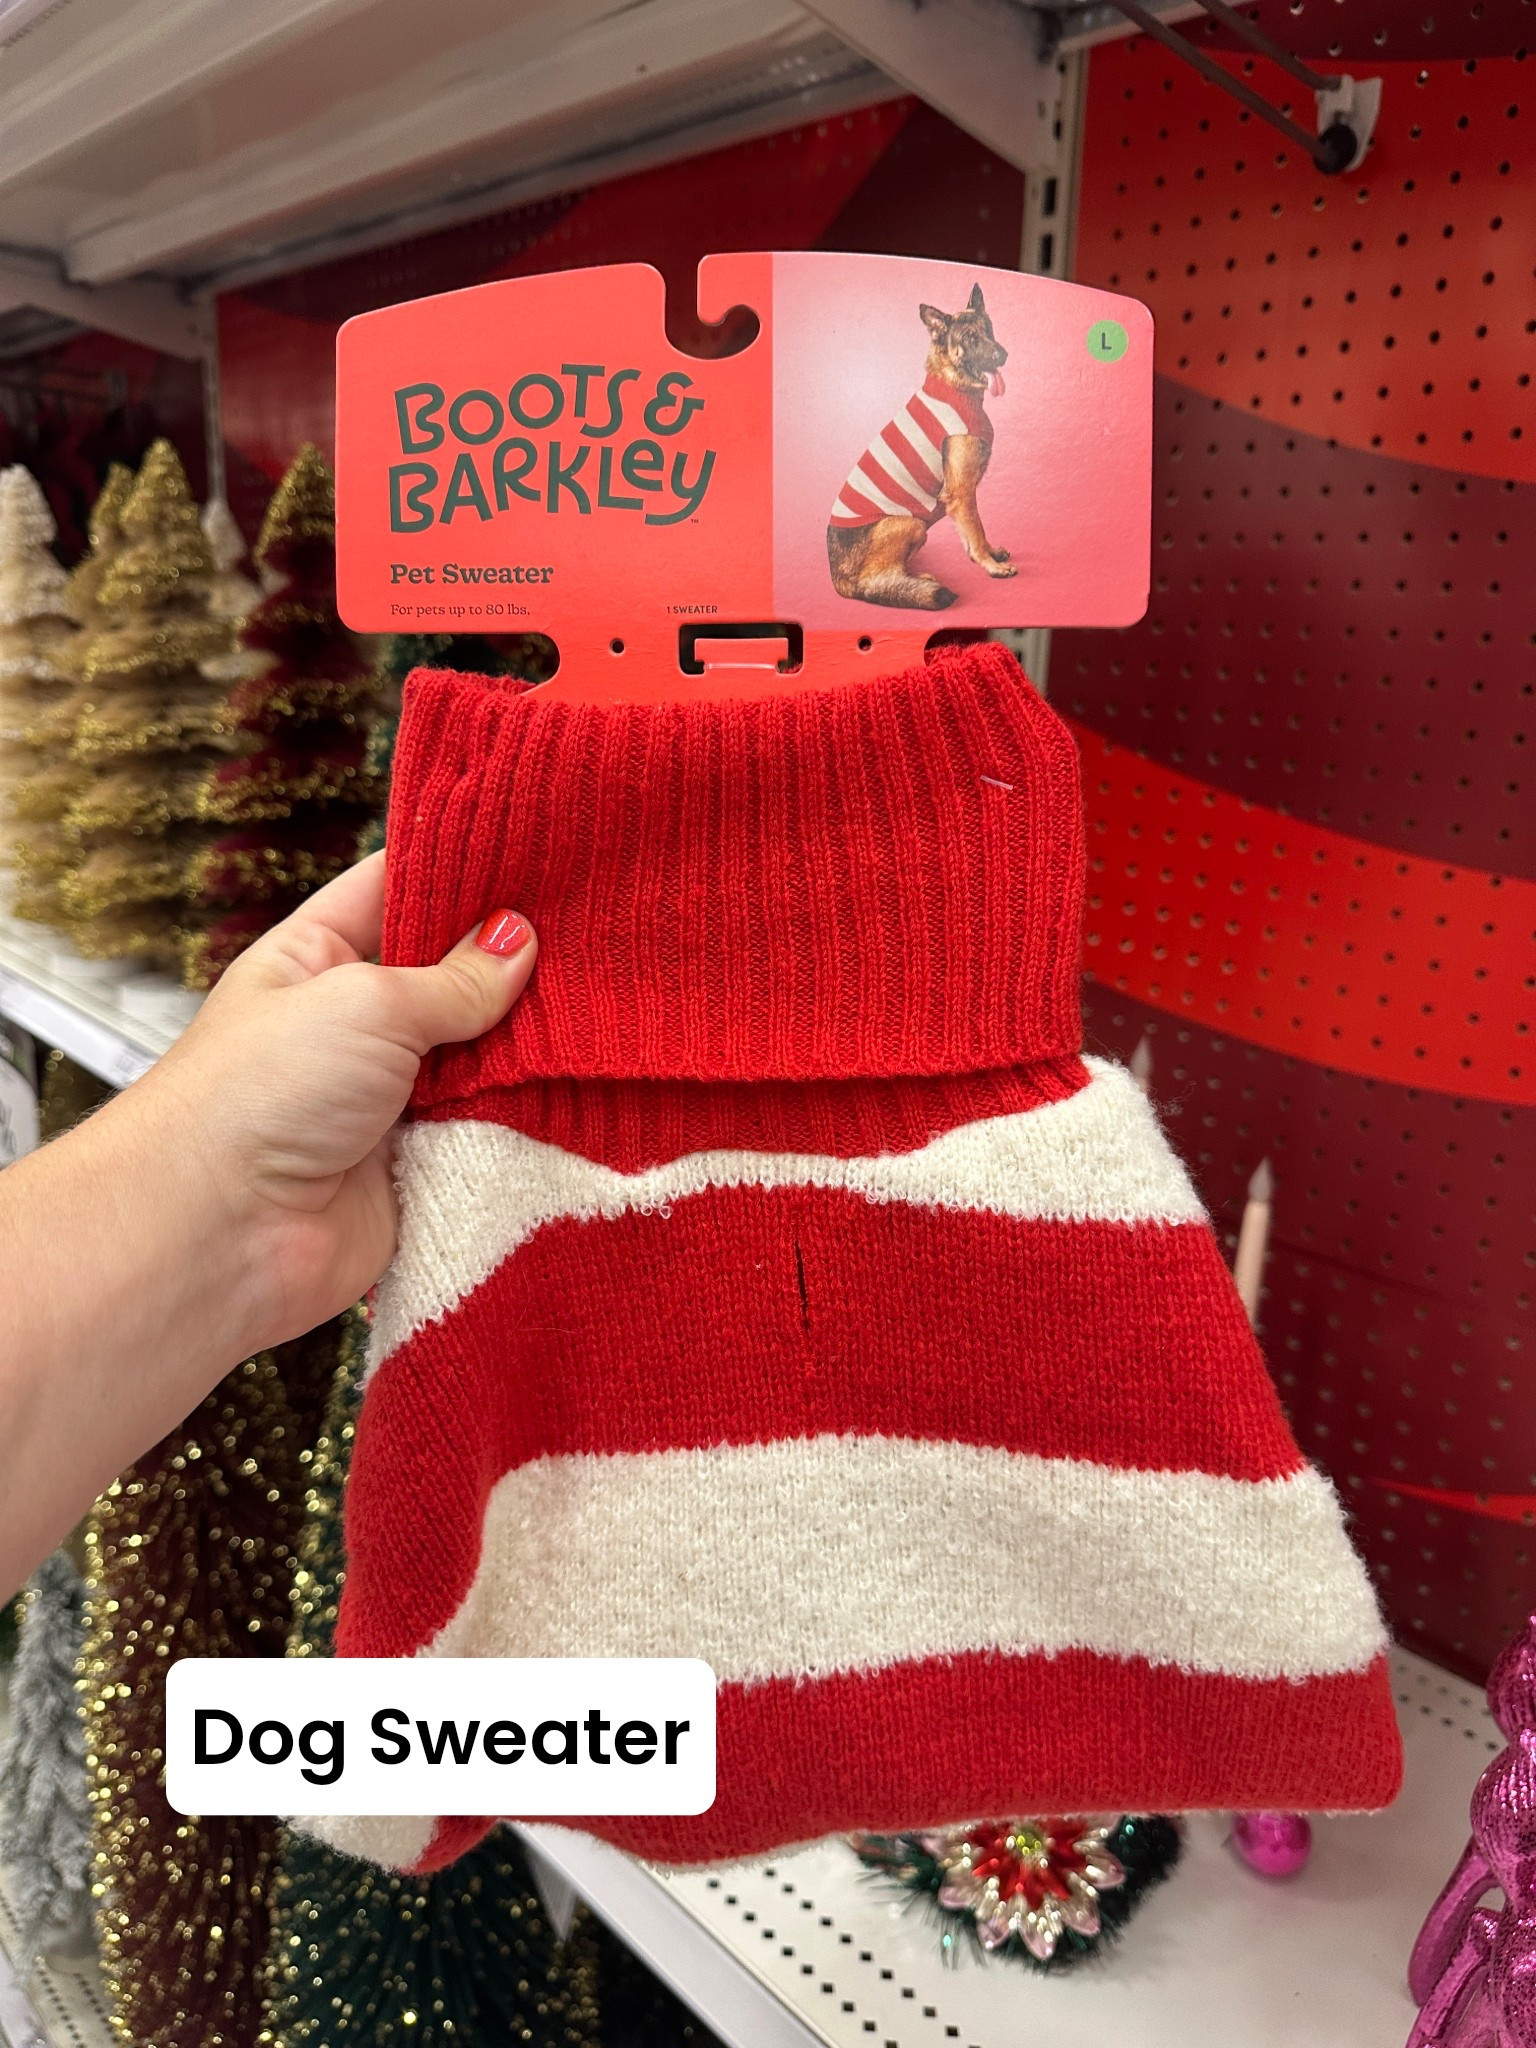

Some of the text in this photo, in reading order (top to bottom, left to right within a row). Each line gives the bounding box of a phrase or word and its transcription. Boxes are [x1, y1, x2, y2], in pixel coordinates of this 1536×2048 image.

[1101, 332, 1112, 350] L
[394, 363, 705, 454] BOOTS &
[390, 563, 554, 584] Pet Sweater
[390, 603, 531, 618] For pets up to 80 lbs.
[667, 605, 718, 614] 1 SWEATER
